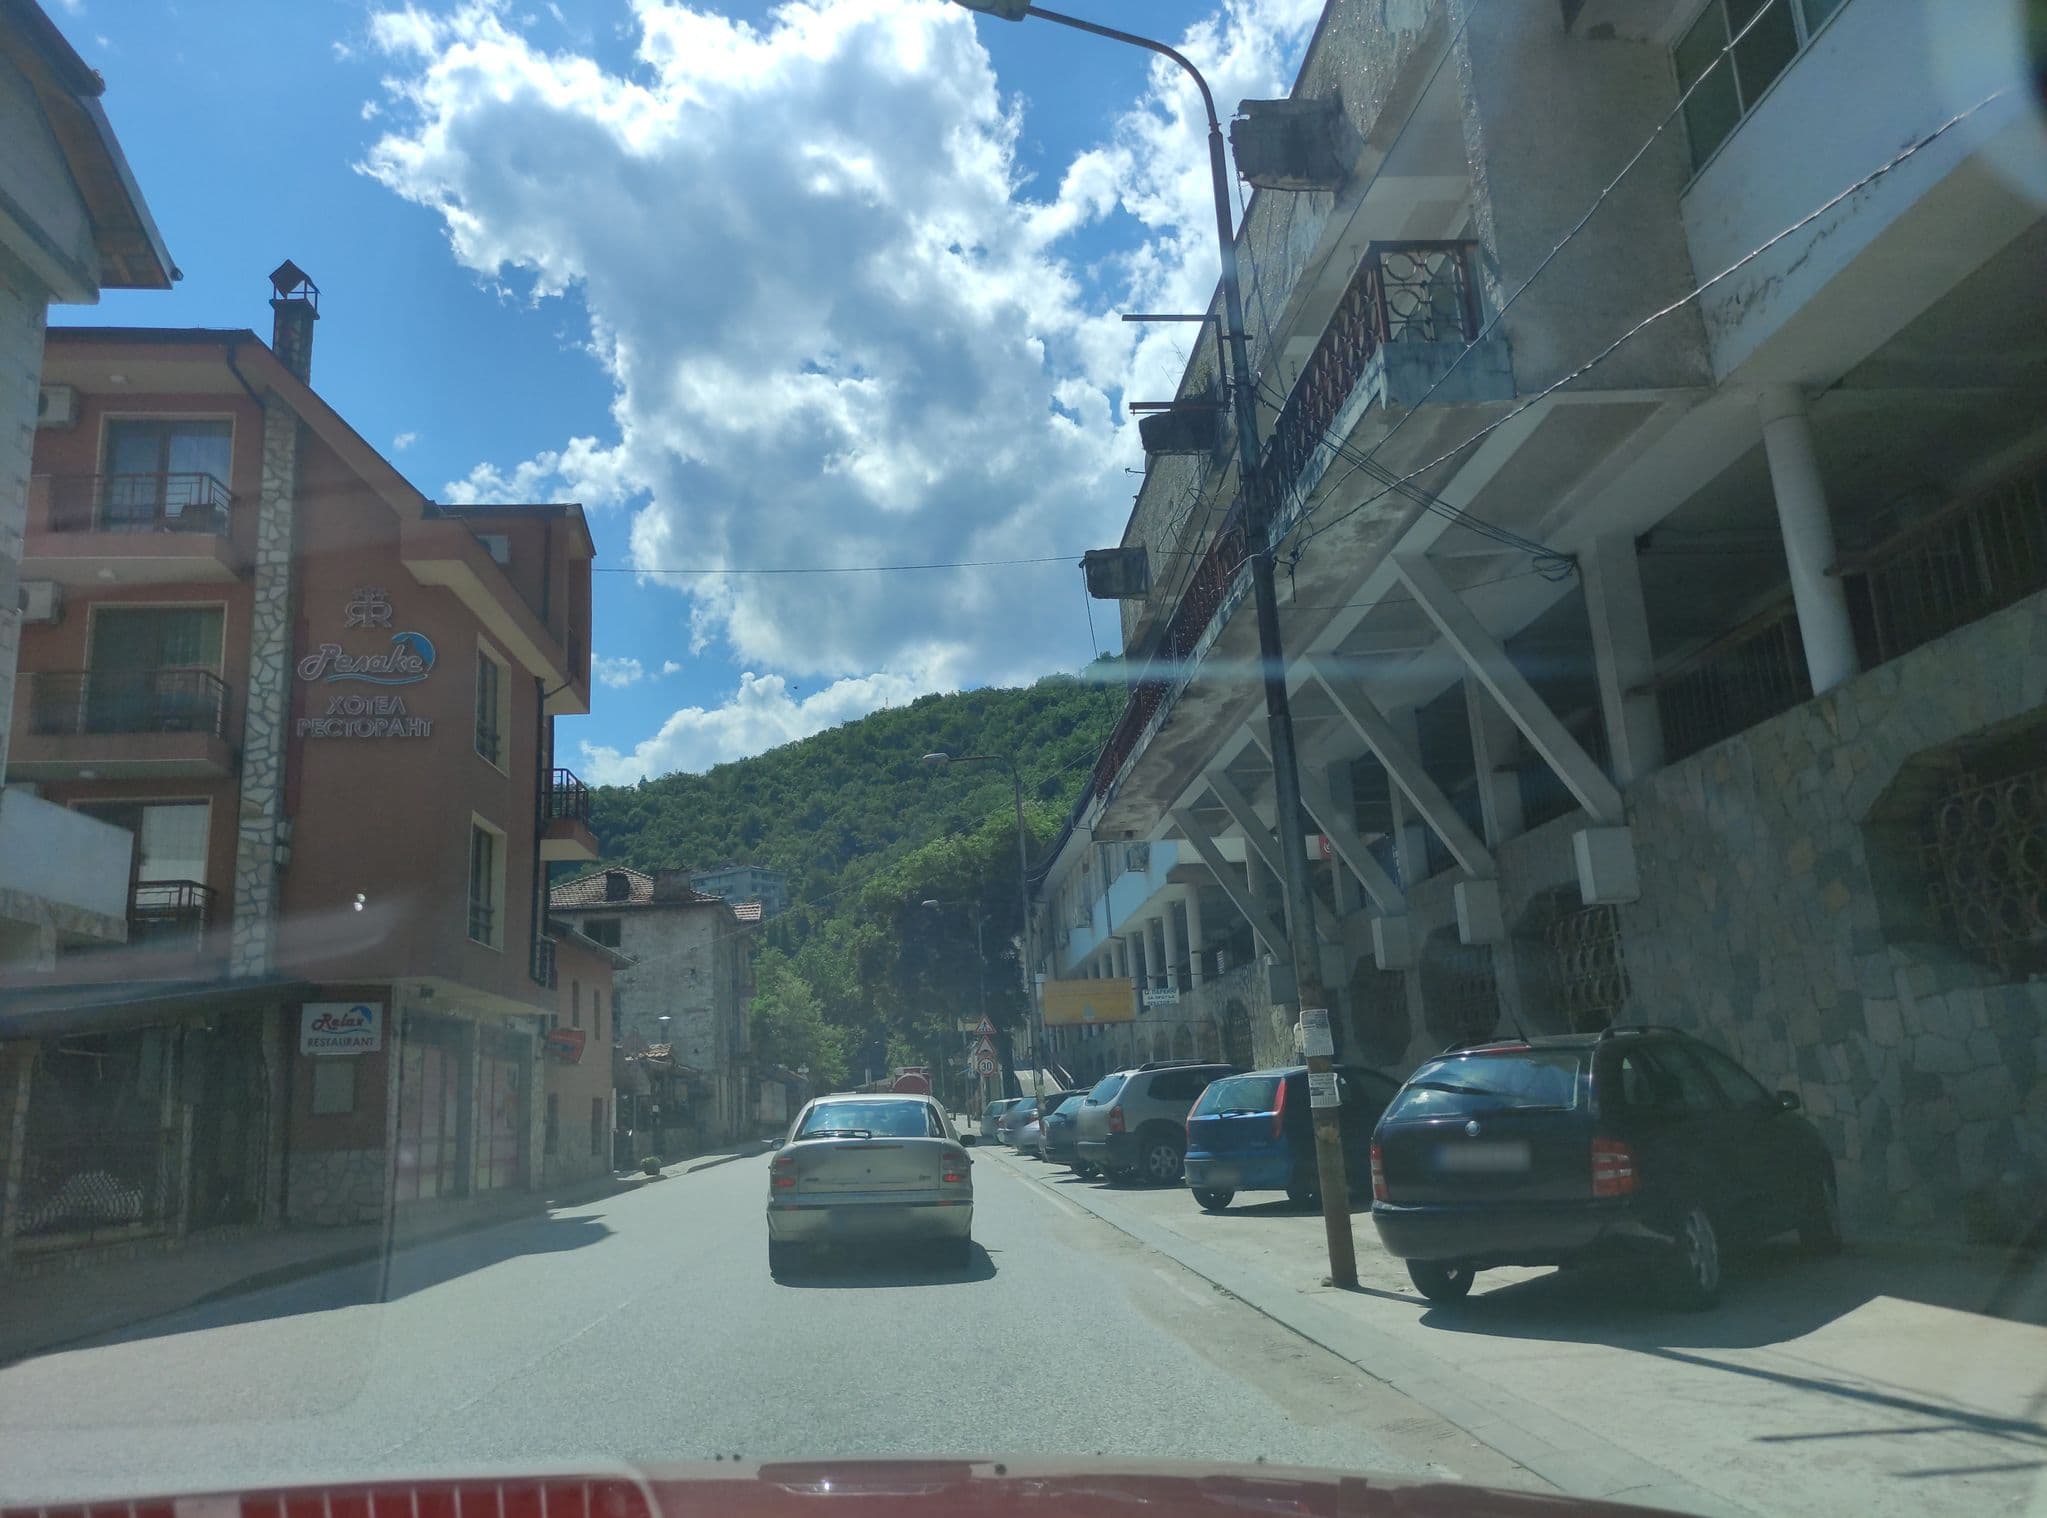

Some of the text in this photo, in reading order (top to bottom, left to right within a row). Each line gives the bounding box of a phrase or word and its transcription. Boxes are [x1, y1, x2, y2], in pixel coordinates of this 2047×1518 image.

[327, 695, 406, 714] ХОТЕЛ
[297, 718, 432, 737] РЕСТОРАНТ
[312, 1013, 364, 1030] Relax
[308, 1037, 374, 1048] RESTAURANT
[981, 1061, 992, 1072] 30
